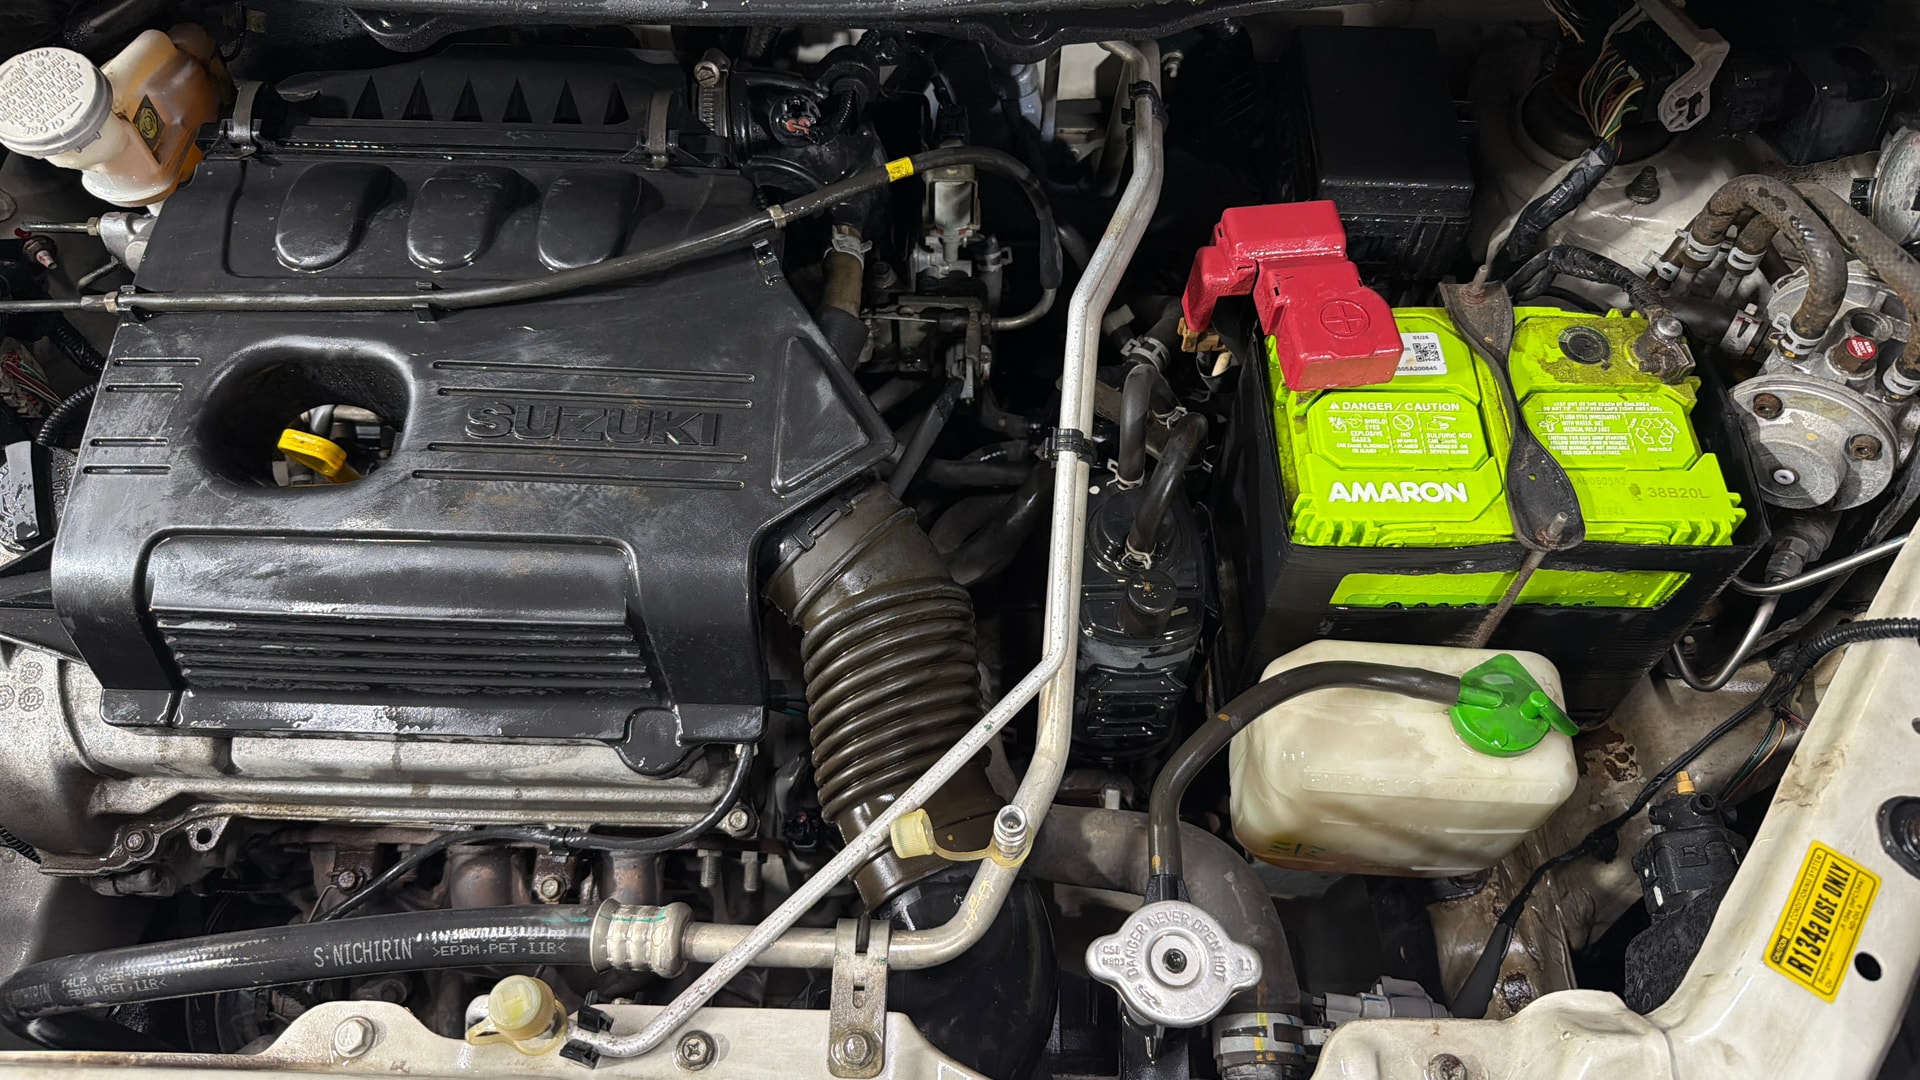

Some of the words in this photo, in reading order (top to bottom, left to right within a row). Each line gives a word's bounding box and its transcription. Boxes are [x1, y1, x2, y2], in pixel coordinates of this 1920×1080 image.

[464, 402, 721, 446] SUZUKI
[1342, 403, 1393, 411] DANGER
[1405, 403, 1460, 411] CAUTION
[1328, 481, 1468, 504] AMARON
[1647, 487, 1711, 499] 38B20L
[1822, 861, 1851, 898] ONLY
[1772, 938, 1788, 961] CAUTION
[1808, 854, 1822, 878] SYSTEM
[1811, 893, 1838, 924] USE
[1125, 924, 1149, 979] DANGER
[1148, 910, 1190, 928] NEVER
[1193, 918, 1223, 951] OPEN
[1213, 955, 1227, 982] HOT
[1786, 920, 1830, 977] R134a
